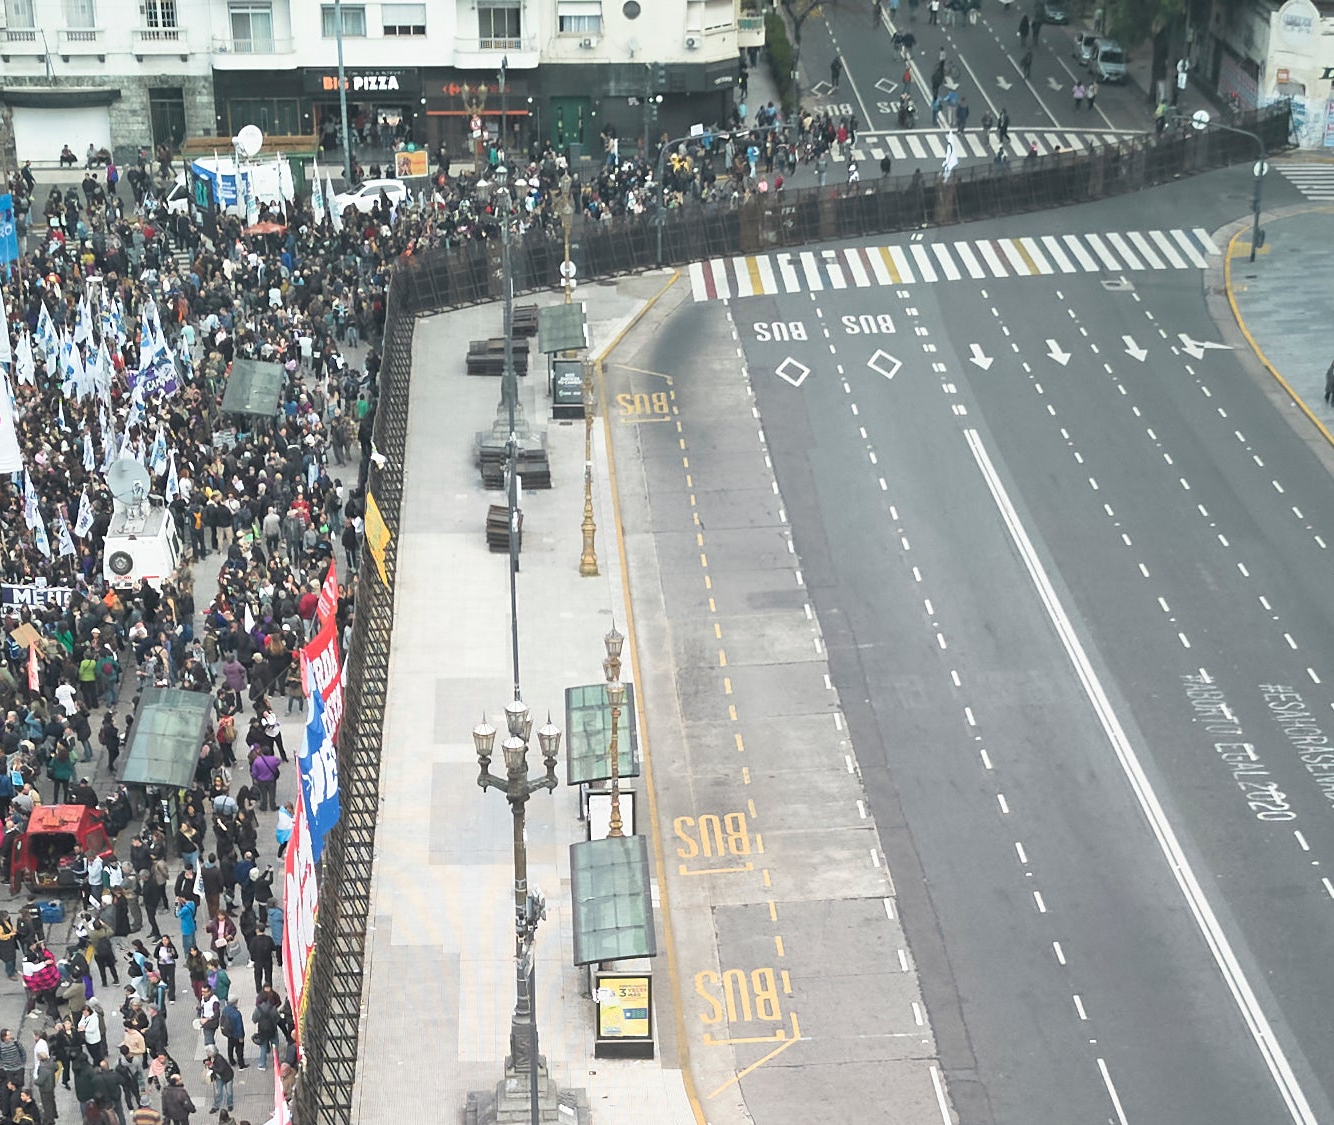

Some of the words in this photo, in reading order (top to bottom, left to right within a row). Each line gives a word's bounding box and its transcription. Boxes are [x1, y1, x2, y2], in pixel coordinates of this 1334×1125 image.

[352, 75, 400, 91] PIZZA
[753, 321, 808, 341] BUS
[841, 314, 896, 334] BUS
[617, 391, 669, 415] BUS
[674, 812, 751, 858] BUS
[695, 967, 782, 1024] BUS
